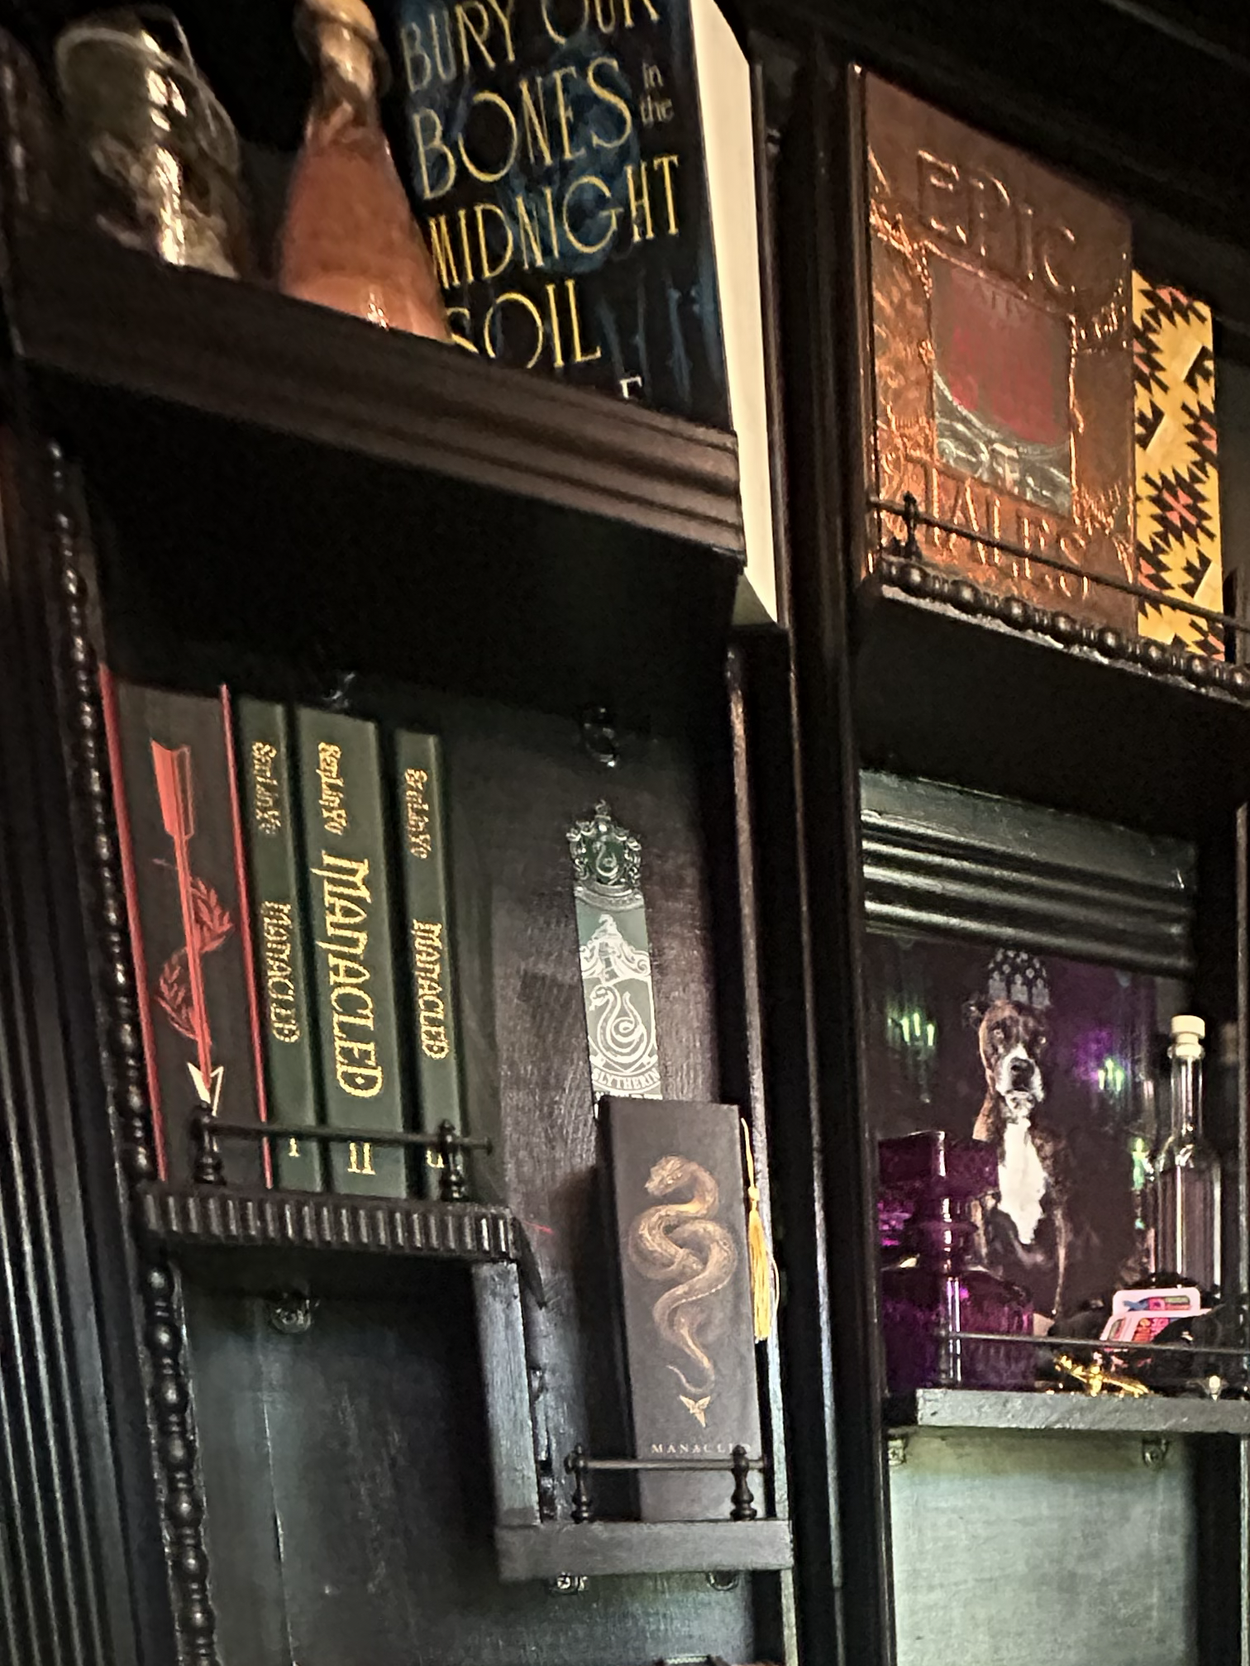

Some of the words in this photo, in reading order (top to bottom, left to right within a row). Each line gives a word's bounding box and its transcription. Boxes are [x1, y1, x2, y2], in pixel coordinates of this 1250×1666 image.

[401, 0, 516, 93] BURY
[641, 95, 674, 127] the
[642, 62, 663, 90] in
[413, 57, 634, 200] BONES
[428, 154, 680, 290] MIDNIGHT
[915, 148, 1076, 296] EPIC
[260, 900, 300, 1045] MANACLED
[310, 850, 385, 1099] MANACLED
[411, 919, 452, 1062] MANACLED
[591, 1067, 661, 1090] SLYTHERIN
[347, 1140, 378, 1177] II
